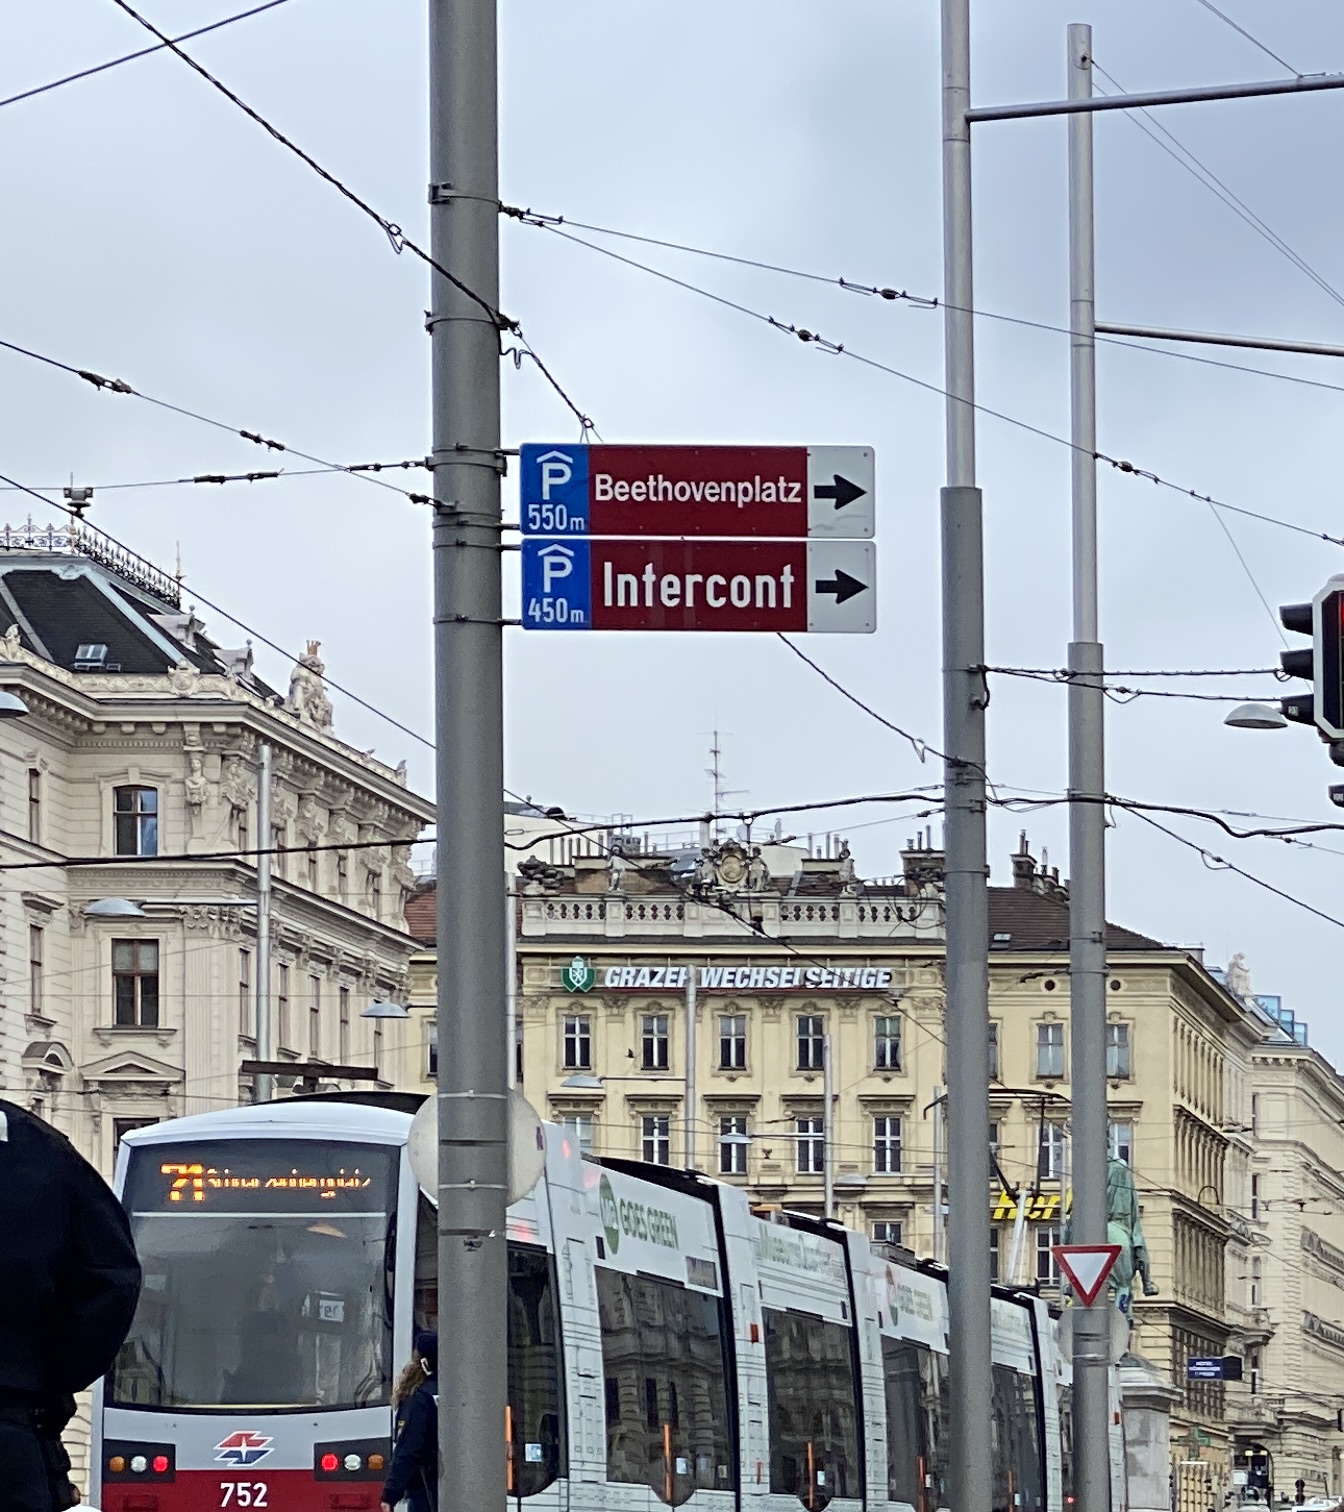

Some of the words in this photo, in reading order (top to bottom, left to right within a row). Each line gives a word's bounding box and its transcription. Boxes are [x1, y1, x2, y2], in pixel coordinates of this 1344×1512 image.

[595, 474, 802, 508] Beethovenplatz
[602, 561, 794, 609] Intercont
[220, 1482, 268, 1508] 752
